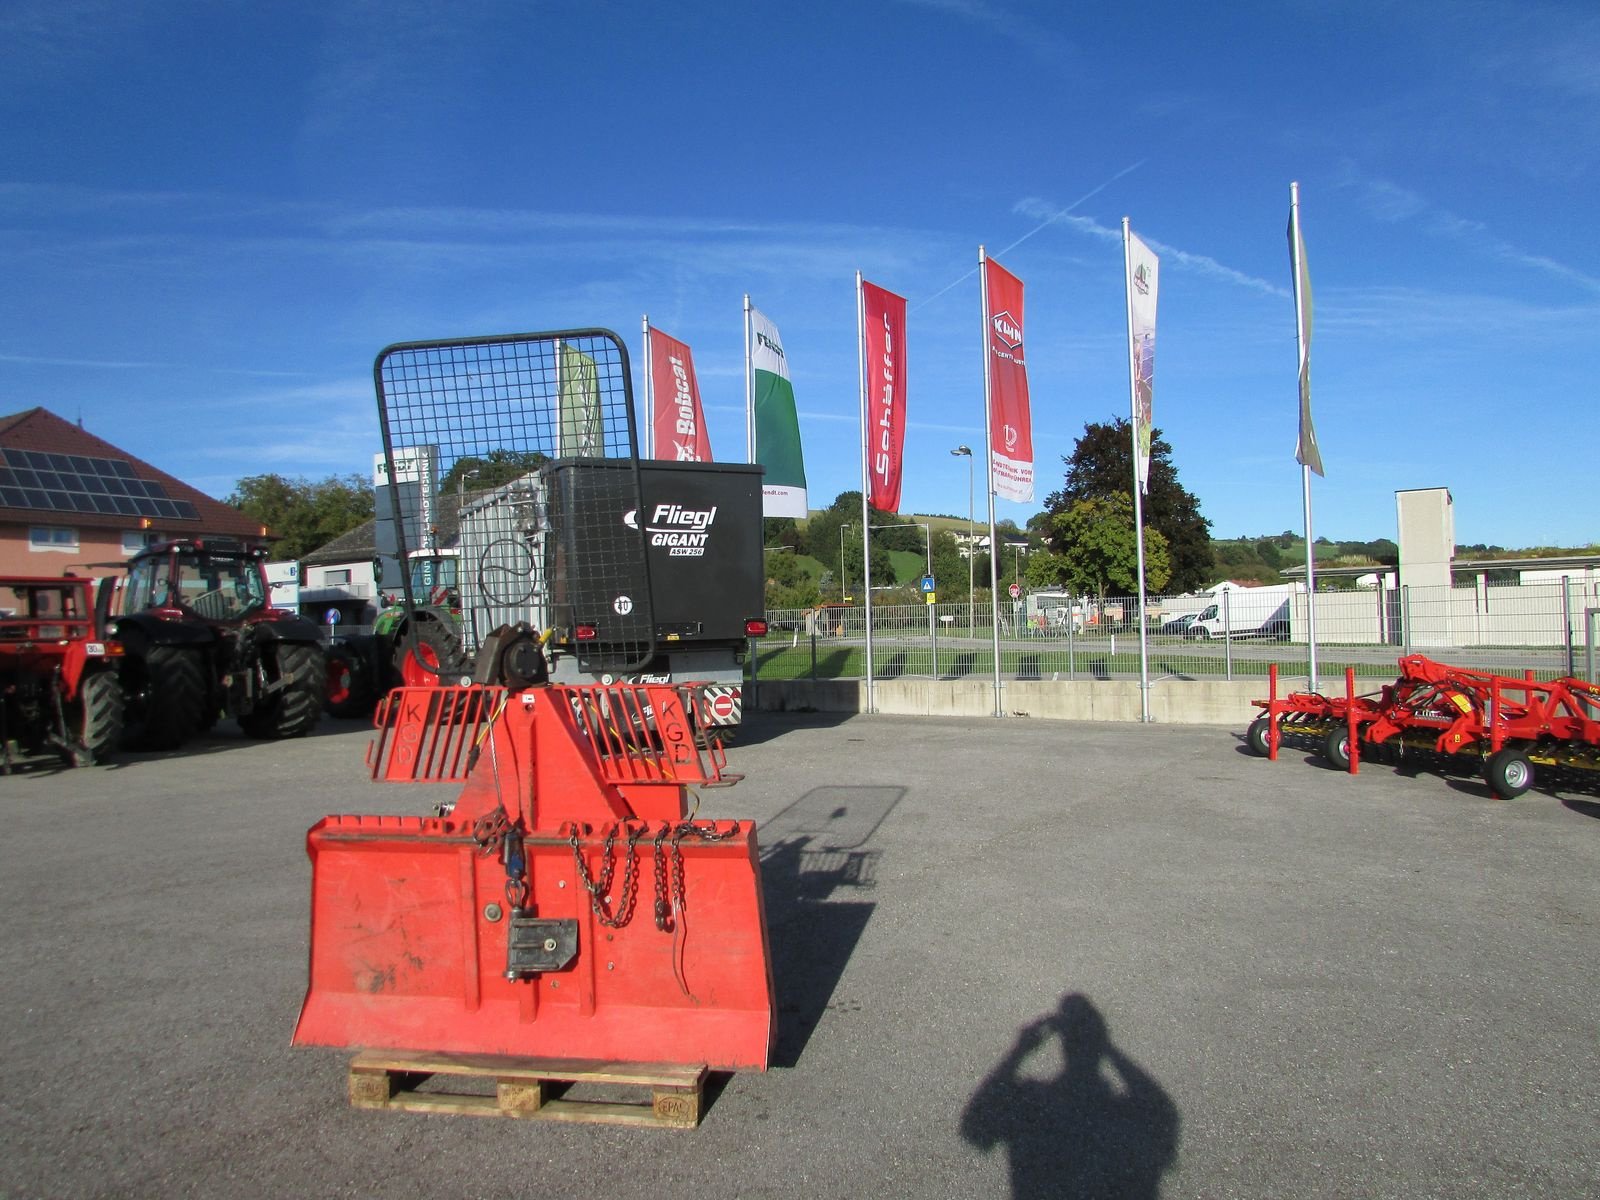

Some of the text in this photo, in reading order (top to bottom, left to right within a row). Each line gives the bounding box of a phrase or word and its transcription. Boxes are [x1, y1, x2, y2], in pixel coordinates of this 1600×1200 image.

[994, 319, 1021, 342] KUHN
[669, 356, 695, 436] Bobcat
[875, 312, 893, 486] Schäffer
[377, 457, 416, 474] FEDT
[652, 504, 717, 529] Fliegl
[651, 533, 709, 547] GIGANT
[640, 673, 670, 684] Fliegl
